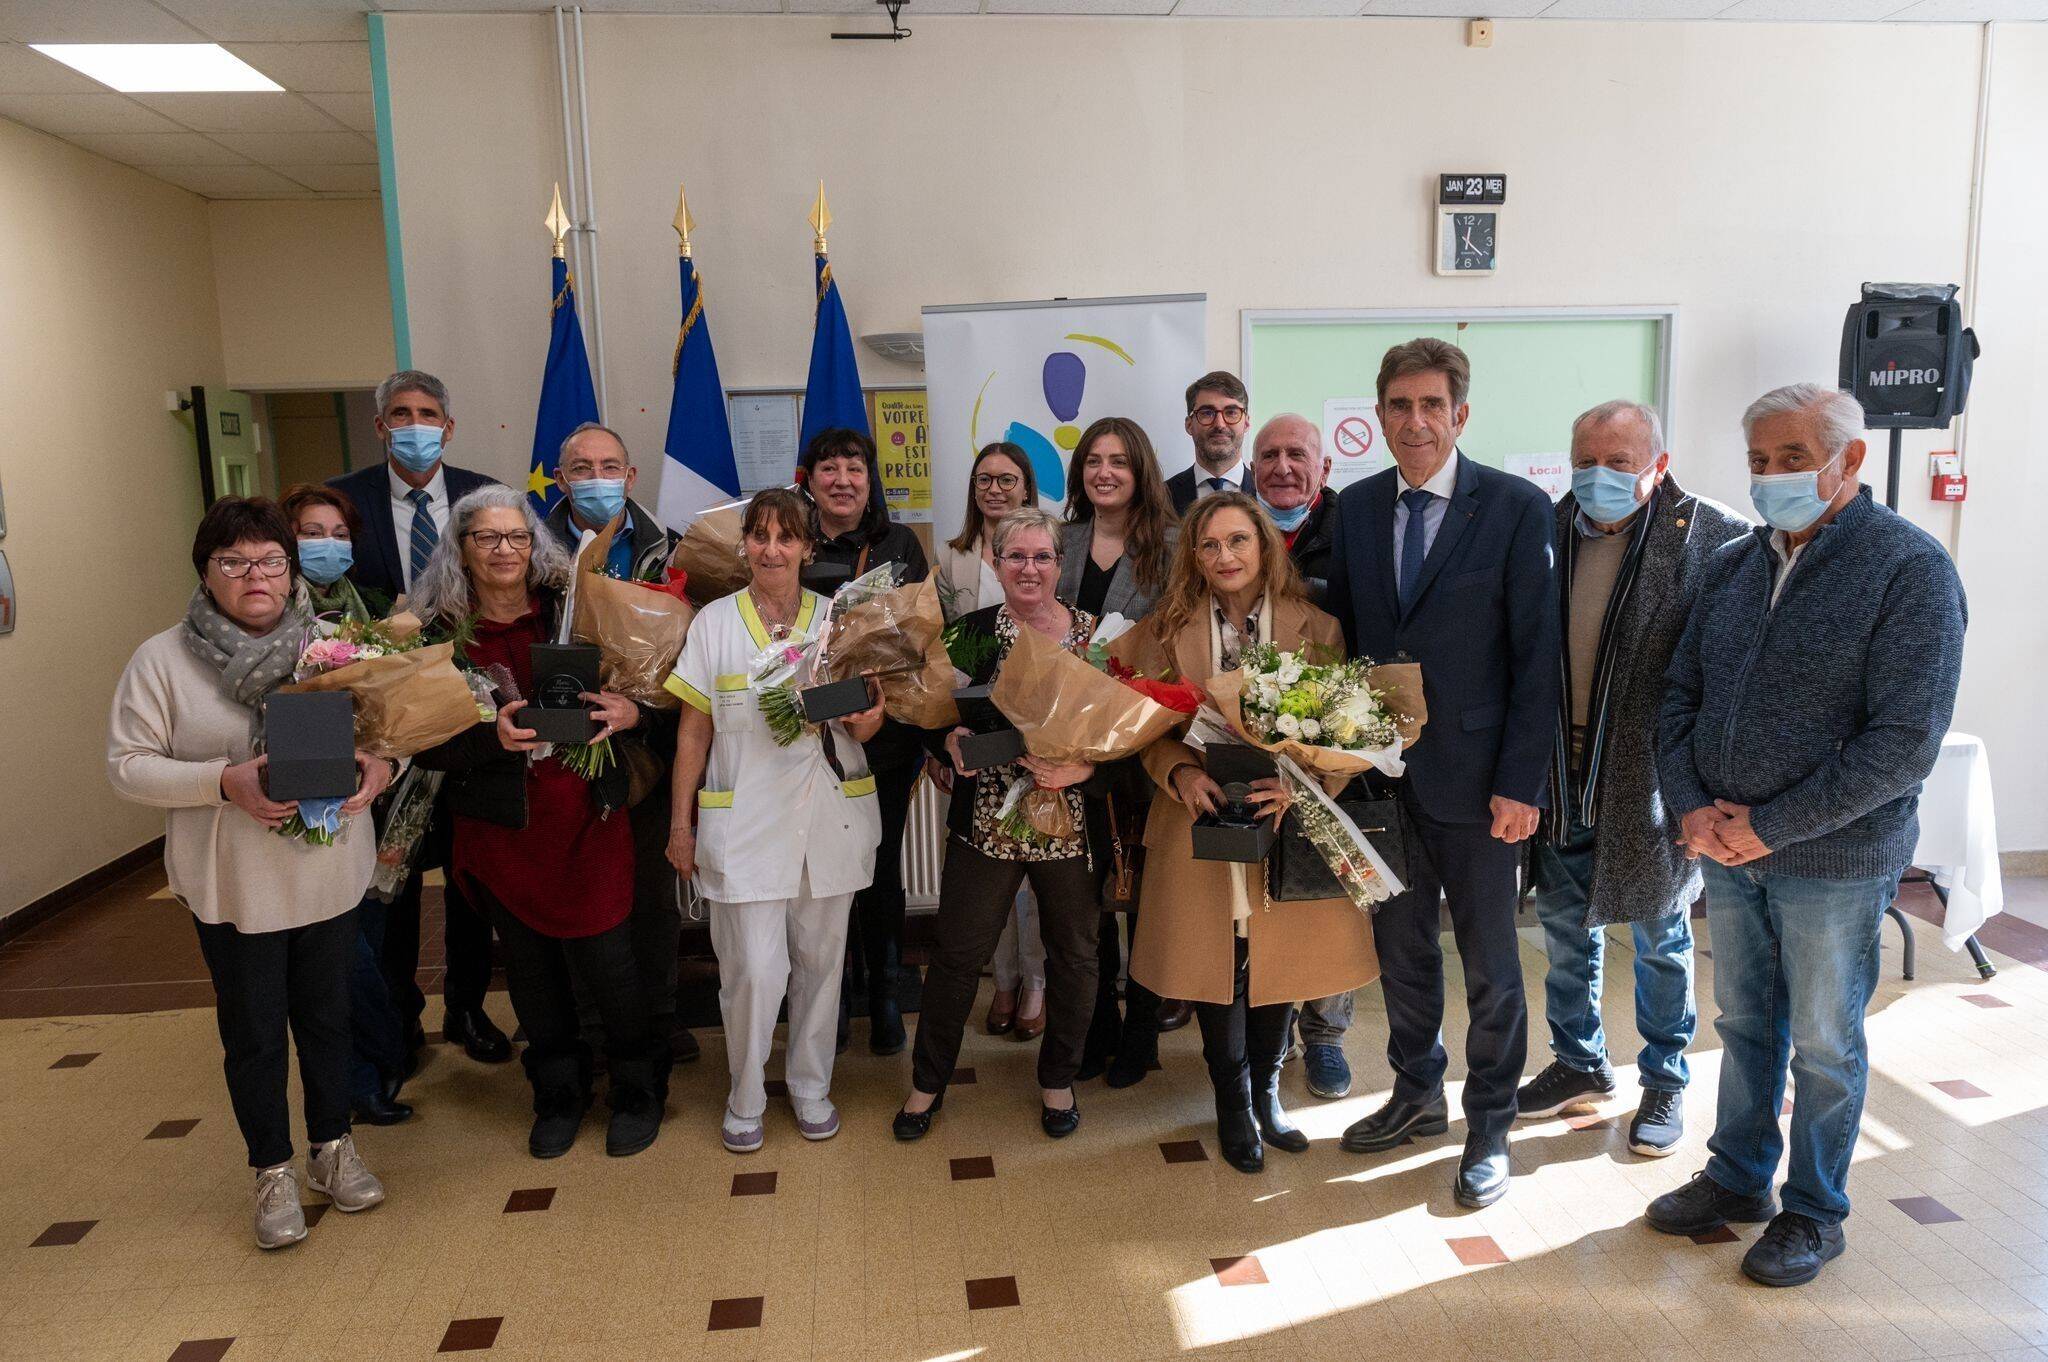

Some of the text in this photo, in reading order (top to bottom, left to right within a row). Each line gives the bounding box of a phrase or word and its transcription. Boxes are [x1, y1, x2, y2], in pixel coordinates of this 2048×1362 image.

[1446, 178, 1503, 195] JAN 23 MER
[1463, 215, 1475, 225] 12
[1486, 236, 1493, 247] 3
[1464, 258, 1472, 268] 6
[882, 410, 925, 424] VOTRE
[915, 425, 929, 444] A
[905, 445, 927, 459] EST
[1529, 465, 1561, 475] Local
